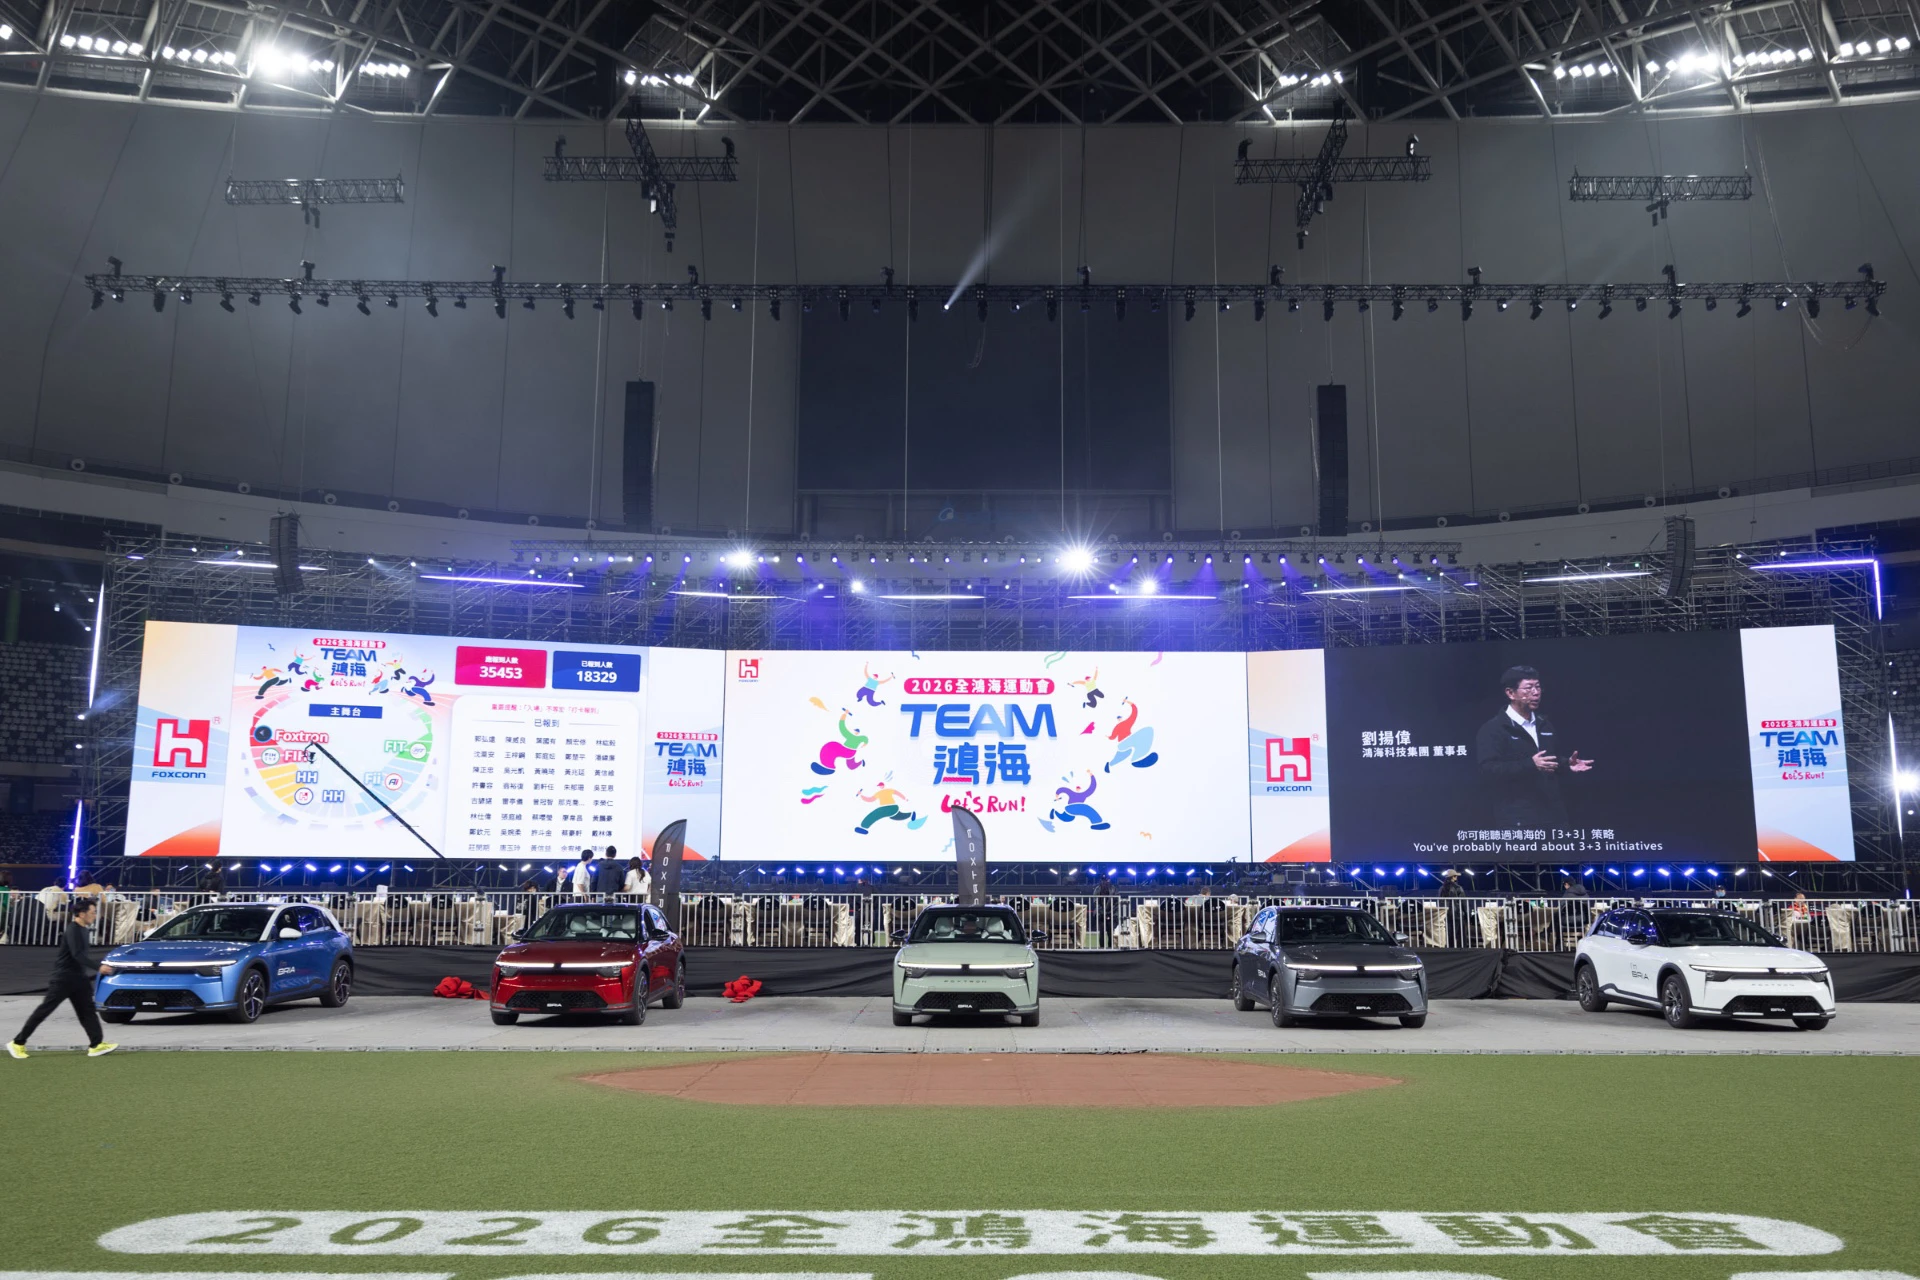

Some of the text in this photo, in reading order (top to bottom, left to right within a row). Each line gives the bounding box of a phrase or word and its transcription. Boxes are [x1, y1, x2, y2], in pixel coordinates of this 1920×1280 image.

[321, 648, 376, 661] TEAM
[331, 662, 366, 677] 鴻海
[480, 666, 522, 680] 35453
[576, 671, 617, 683] 18329
[912, 680, 1050, 693] 2026全鴻海運動會
[330, 707, 362, 717] 主舞台
[534, 718, 560, 728] 已報到
[900, 704, 1057, 738] TEAM
[275, 730, 328, 743] Foxtron
[1362, 730, 1411, 746] 劉揚偉
[1760, 730, 1838, 747] TEAM
[384, 740, 406, 752] FIT
[654, 742, 717, 758] TEAM
[1362, 745, 1467, 758] 鴻海科技集團 董事長
[932, 742, 1032, 785] 鴻海
[1778, 748, 1827, 768] 鴻海
[667, 758, 706, 776] 鴻海
[296, 772, 318, 784] HH
[323, 791, 344, 802] HH
[1414, 841, 1663, 854] You've probably heard about 3+3 initiatives
[1632, 970, 1650, 980] BRIA
[186, 1213, 1777, 1250] 2026全鴻海運動會
